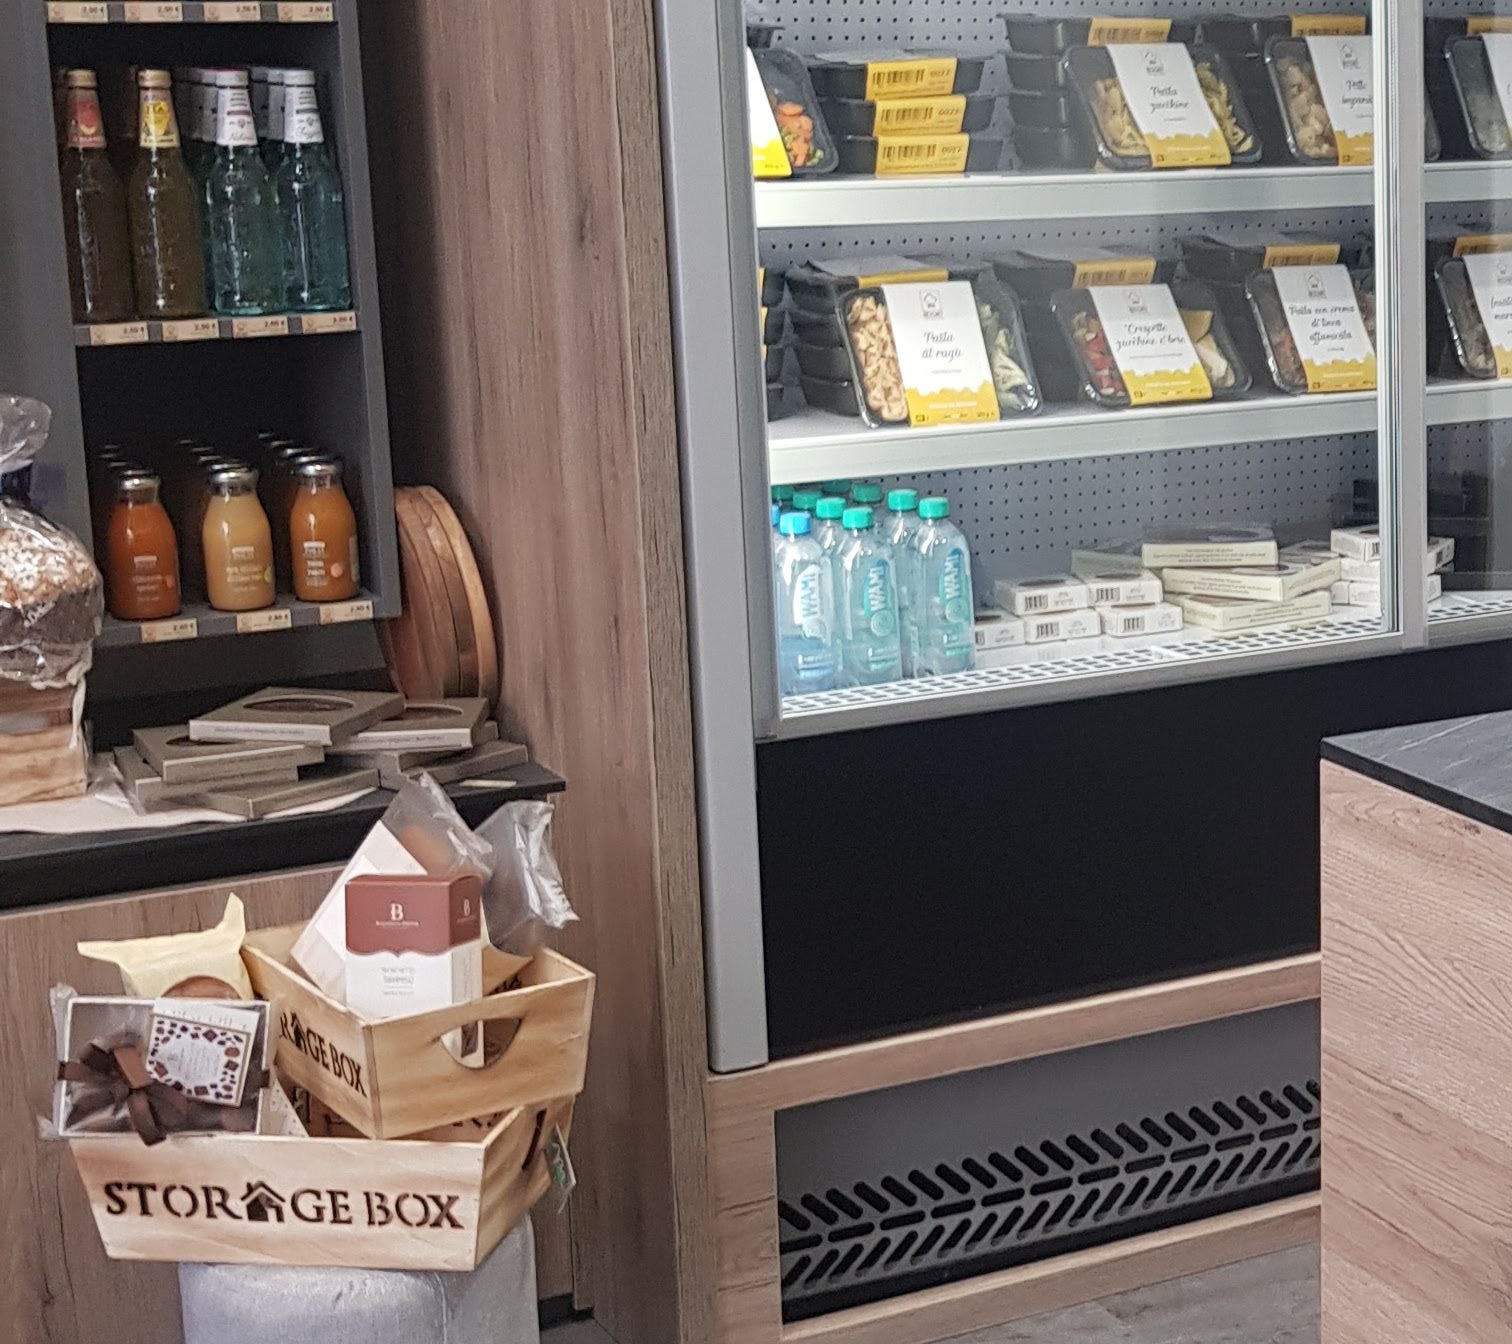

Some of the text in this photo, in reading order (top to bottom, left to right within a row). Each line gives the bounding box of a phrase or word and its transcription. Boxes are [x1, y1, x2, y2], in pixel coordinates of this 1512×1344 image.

[923, 331, 954, 343] Pasta
[801, 572, 820, 619] WAMI
[868, 566, 887, 612] WAMI
[944, 555, 962, 600] WAMI
[390, 903, 404, 921] B
[329, 1042, 368, 1098] BOX
[363, 1190, 465, 1230] BOX
